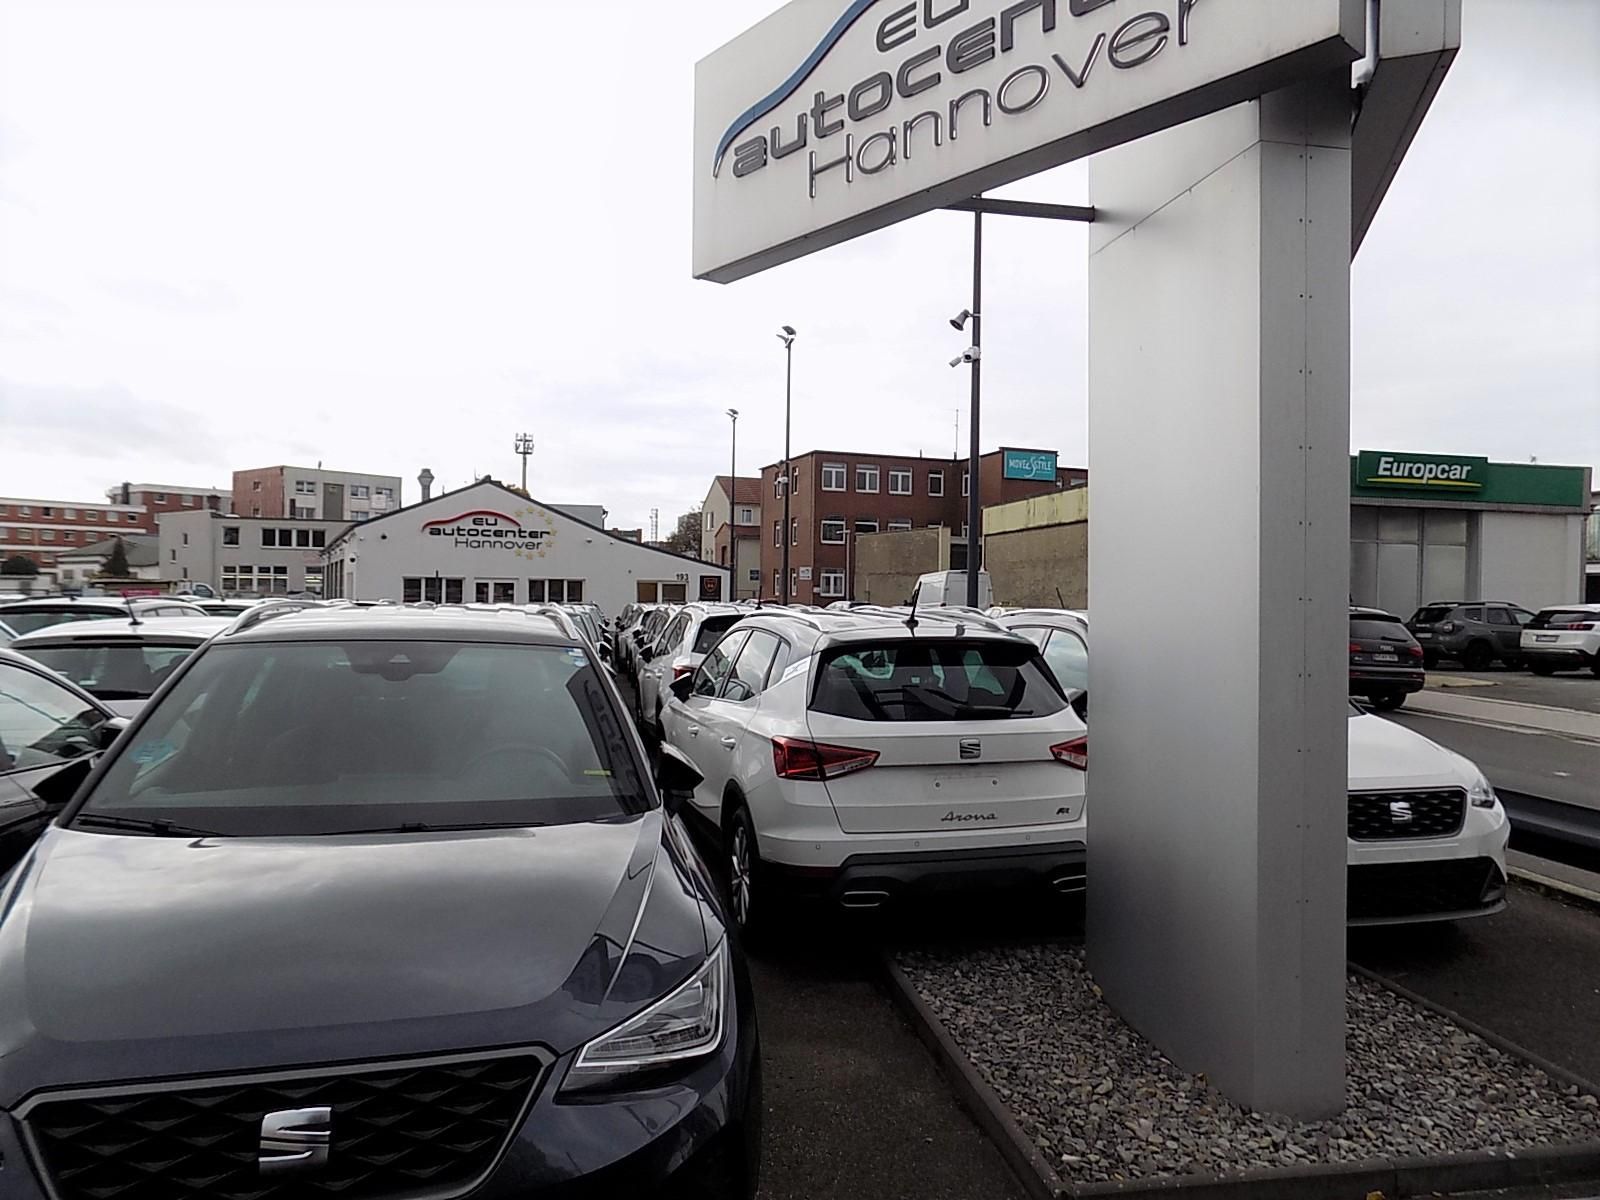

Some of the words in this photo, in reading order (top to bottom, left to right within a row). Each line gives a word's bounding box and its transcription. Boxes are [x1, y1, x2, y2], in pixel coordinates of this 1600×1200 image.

[733, 0, 1117, 178] autocen
[808, 0, 1198, 199] Hannover
[1377, 456, 1472, 484] Europcar
[472, 517, 498, 526] EU
[429, 526, 551, 539] autocenter
[454, 537, 543, 550] Hannover
[675, 573, 689, 581] 193
[940, 810, 998, 822] Arona
